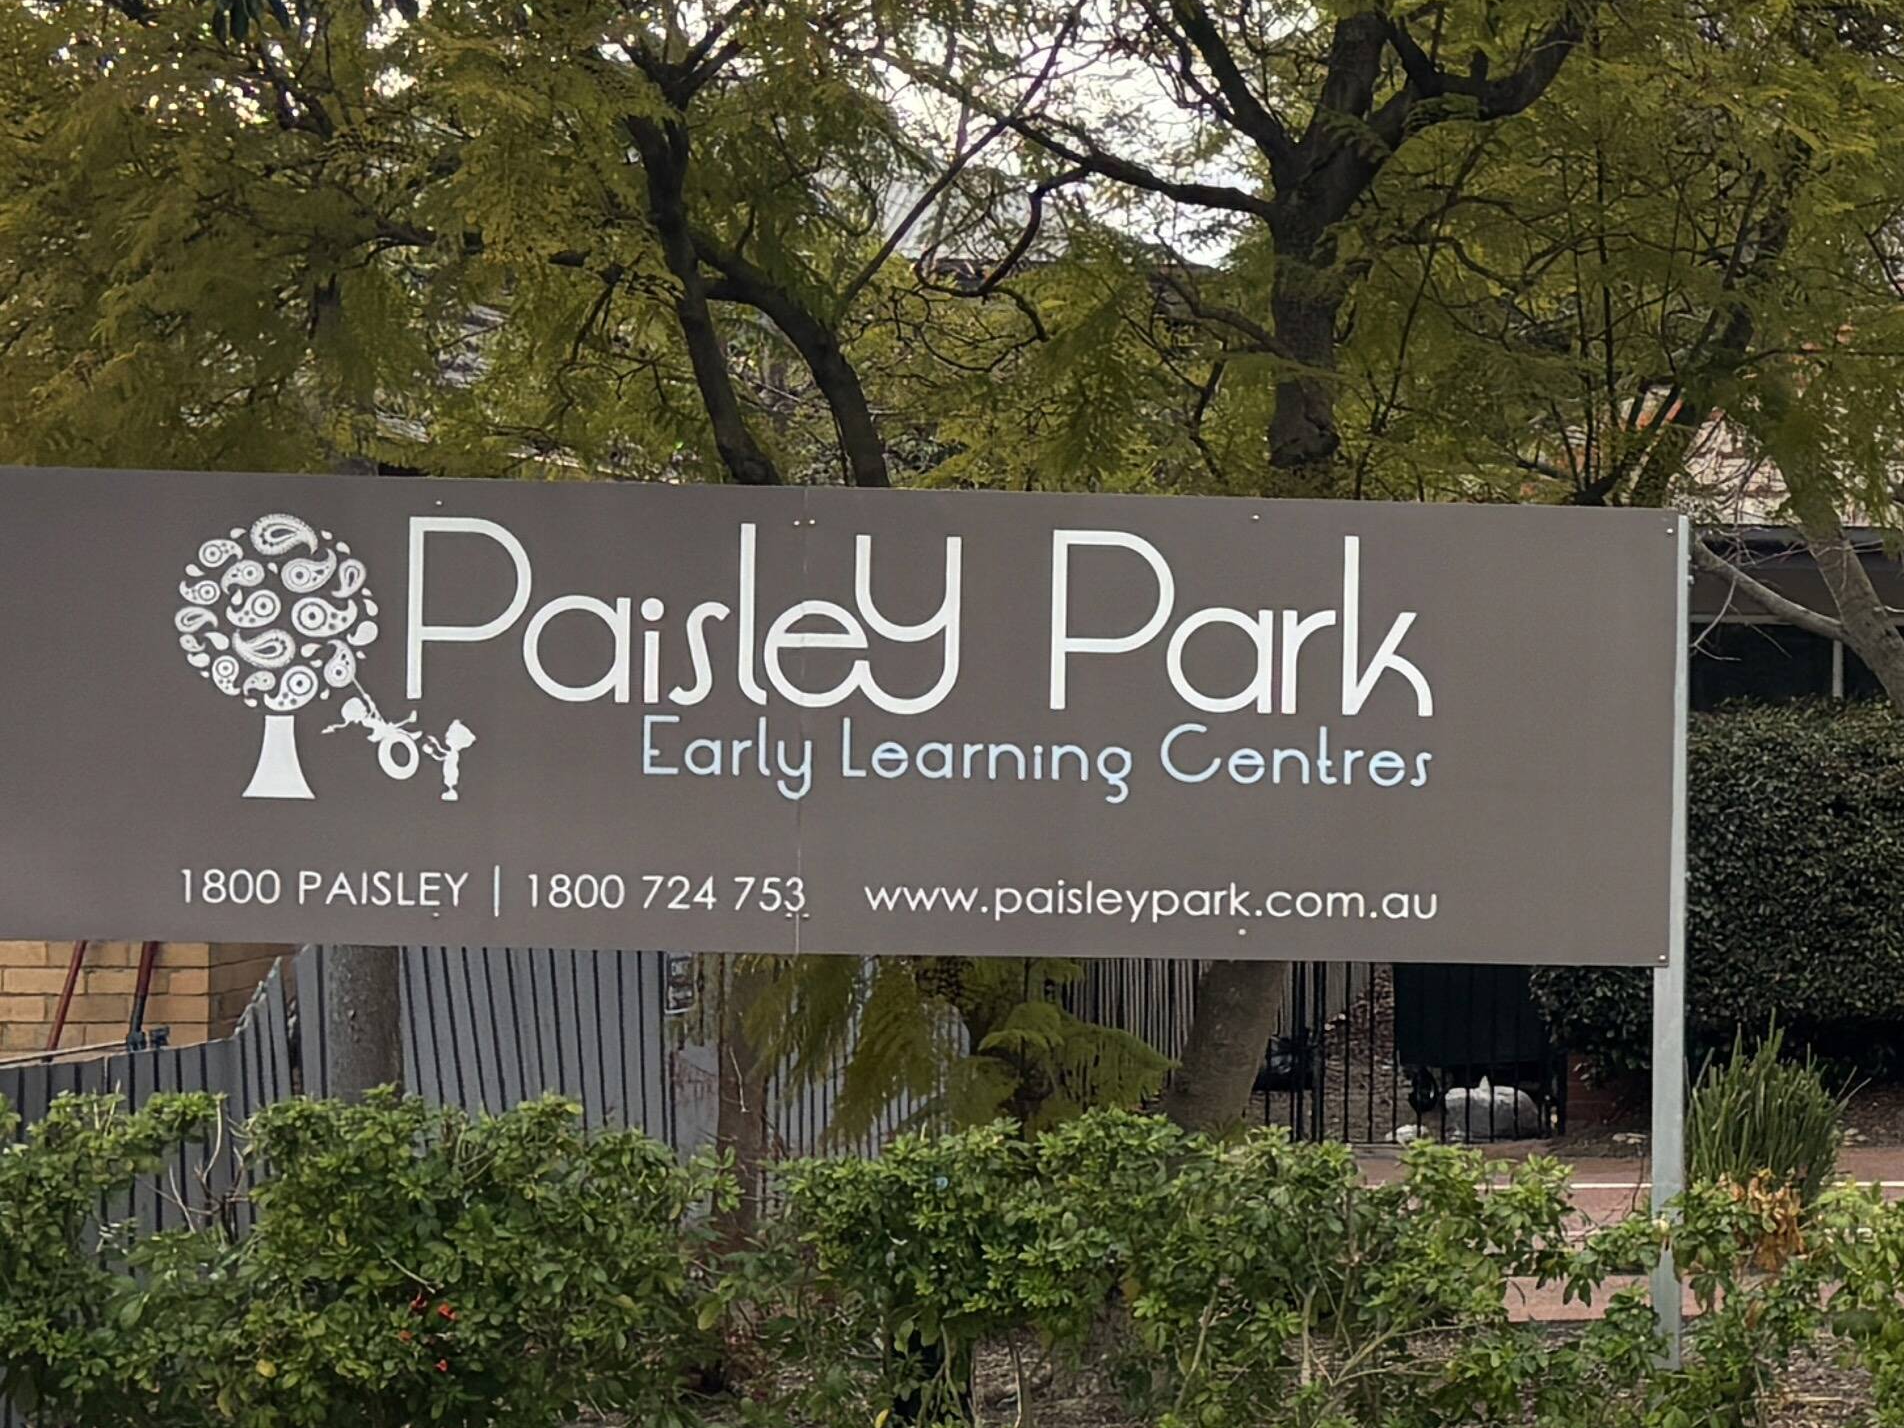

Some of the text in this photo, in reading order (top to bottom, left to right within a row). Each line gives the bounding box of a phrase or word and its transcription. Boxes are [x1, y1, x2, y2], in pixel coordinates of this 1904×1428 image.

[405, 515, 1434, 718] Paisley Park
[642, 713, 1434, 805] Early Learning Centres
[180, 867, 282, 906] 1800
[297, 869, 470, 909] PAISLEY
[527, 872, 626, 910] 1800
[641, 874, 718, 912] 724
[733, 875, 807, 913] 753
[863, 878, 1438, 924] www.paisleypark.com.au
